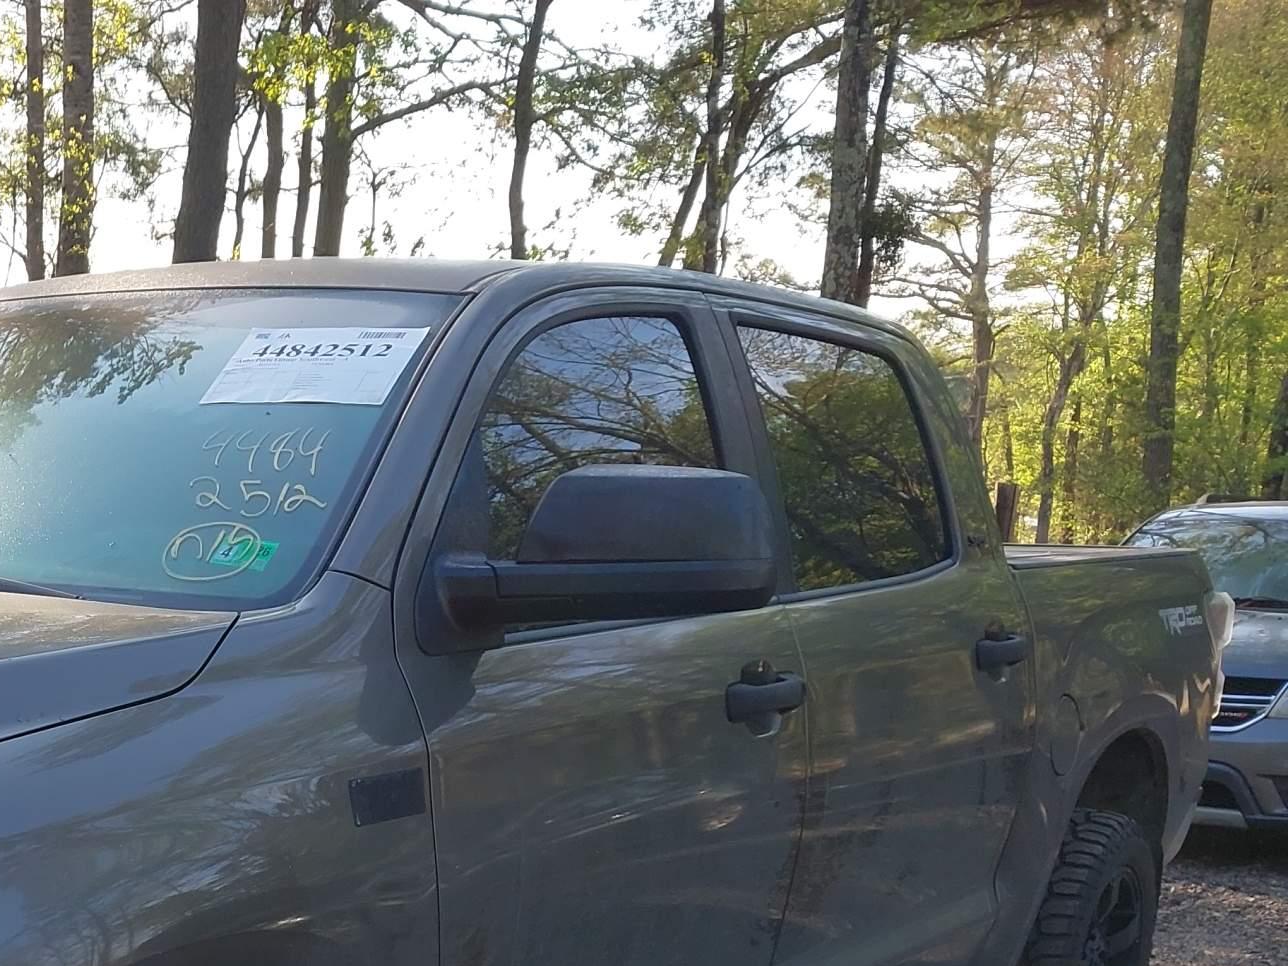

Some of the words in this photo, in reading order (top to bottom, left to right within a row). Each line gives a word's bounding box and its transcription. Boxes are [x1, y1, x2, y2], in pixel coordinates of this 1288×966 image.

[252, 343, 392, 357] 44842512
[189, 476, 328, 518] 2512
[1159, 607, 1185, 635] TRD
